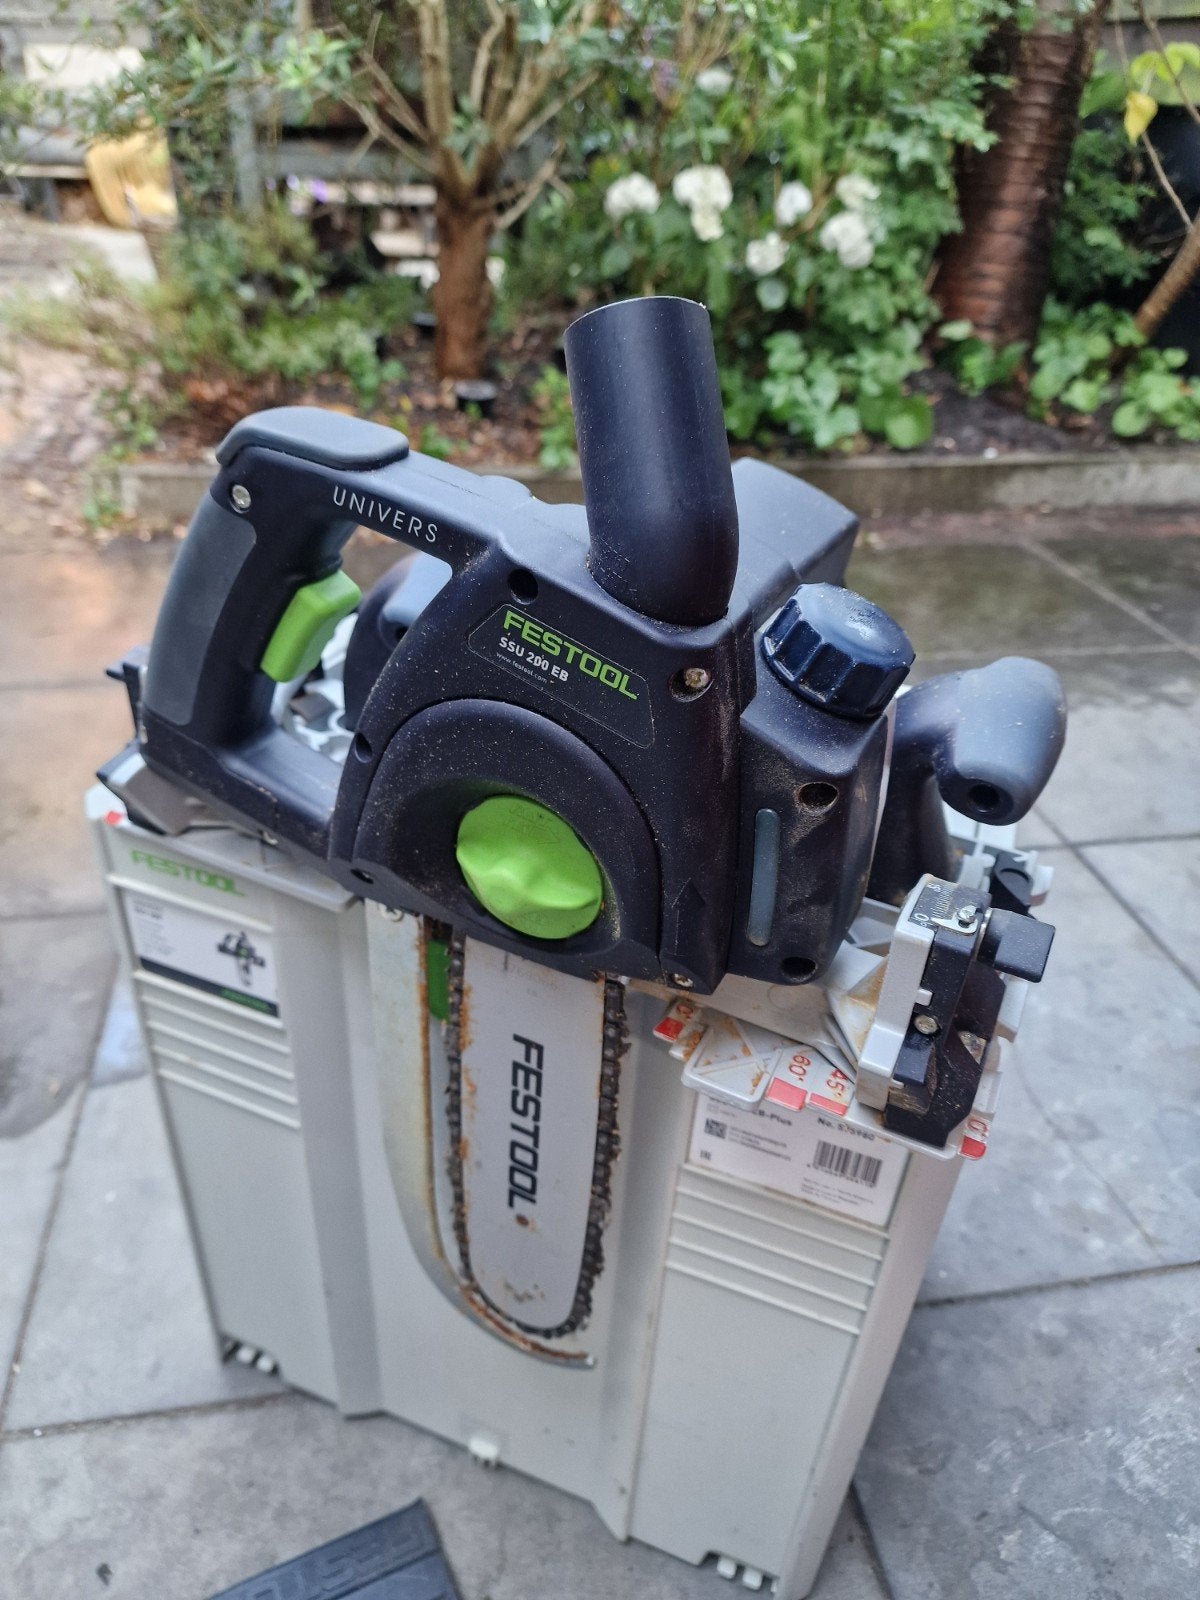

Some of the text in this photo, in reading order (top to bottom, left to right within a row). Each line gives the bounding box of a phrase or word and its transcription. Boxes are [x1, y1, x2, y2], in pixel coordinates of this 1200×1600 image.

[333, 485, 438, 543] UNIVERS
[499, 637, 569, 682] SSU 200 EB
[503, 610, 638, 701] FESTOOL
[508, 1033, 544, 1208] FESTOOL
